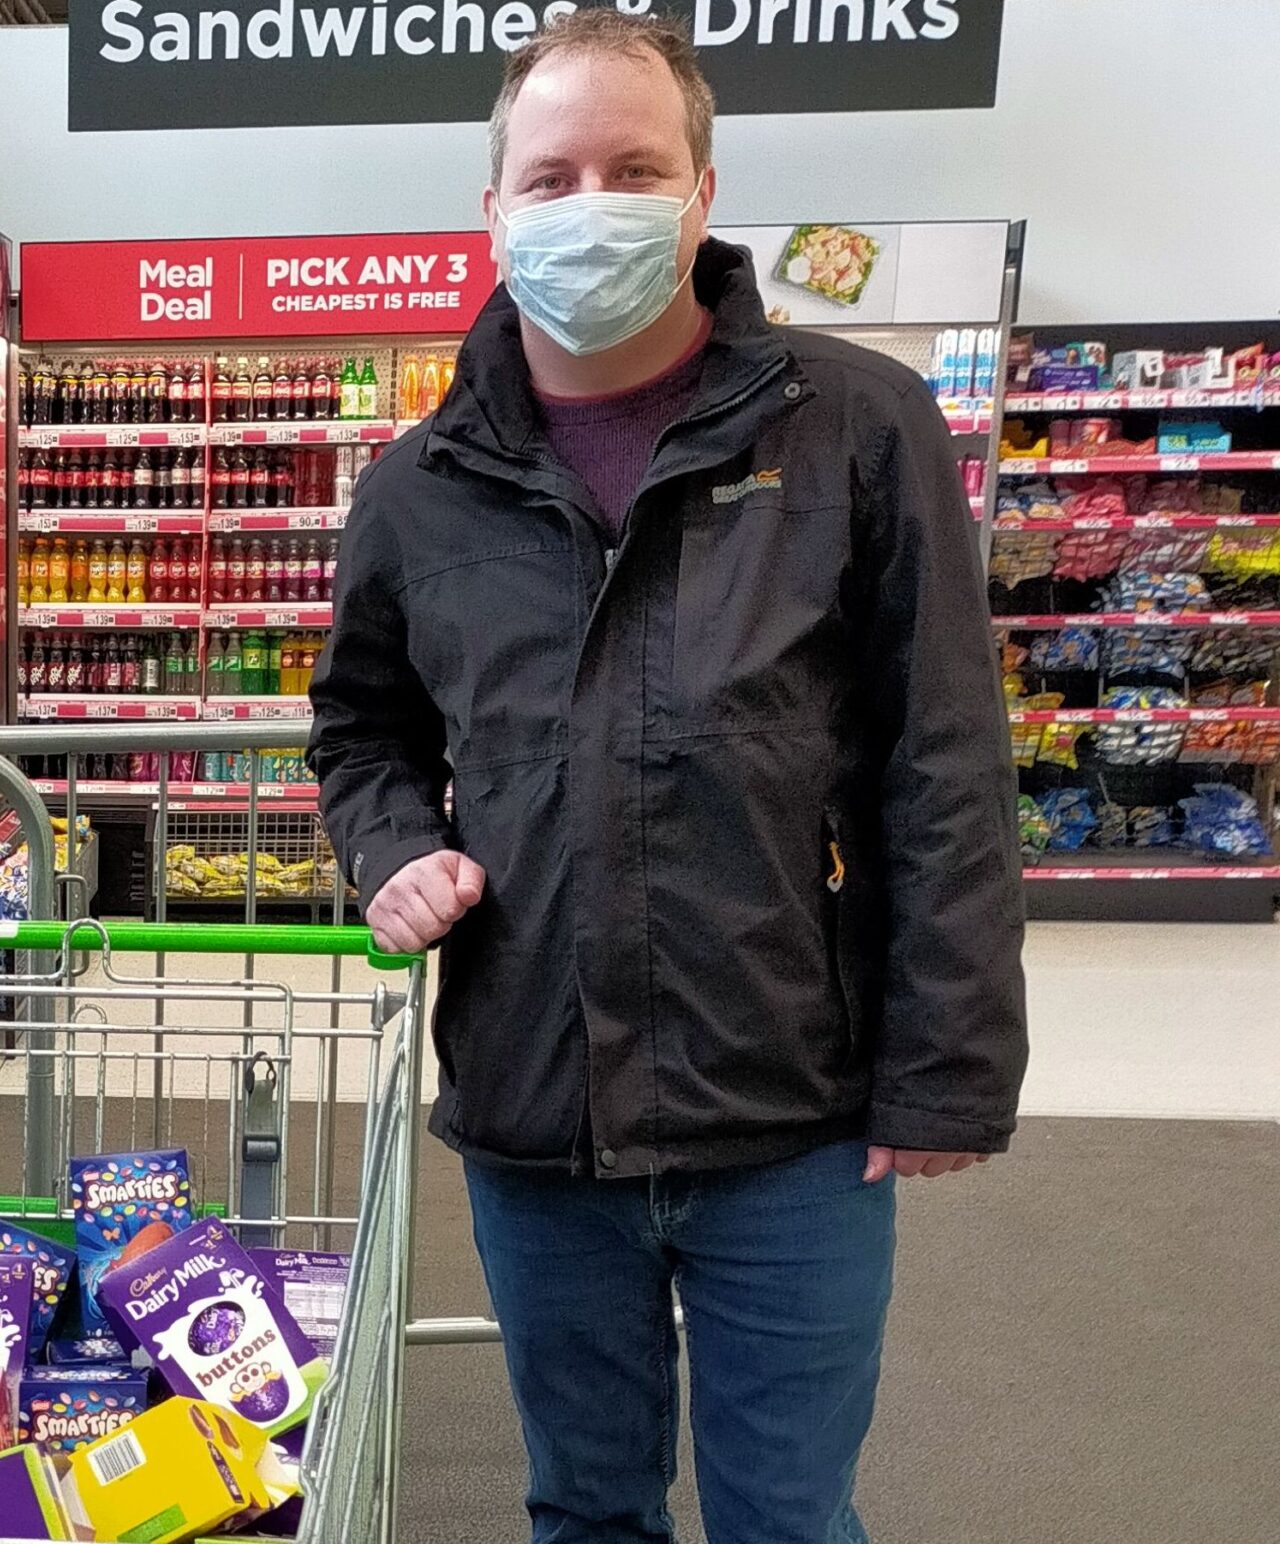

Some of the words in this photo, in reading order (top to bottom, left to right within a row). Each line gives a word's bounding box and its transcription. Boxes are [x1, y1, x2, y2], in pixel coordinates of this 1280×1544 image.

[694, 0, 959, 47] Drinks
[139, 256, 213, 289] Meal
[267, 256, 351, 287] PICK
[357, 253, 439, 285] ANY
[446, 253, 468, 283] 3
[140, 290, 212, 322] Deal
[272, 293, 378, 312] CHEAPEST
[384, 292, 403, 309] IS
[408, 291, 461, 309] FREE
[125, 1277, 180, 1321] Dairy
[173, 1254, 226, 1287] Milk
[130, 1266, 168, 1298] Cadbury
[196, 1329, 276, 1387] buttons
